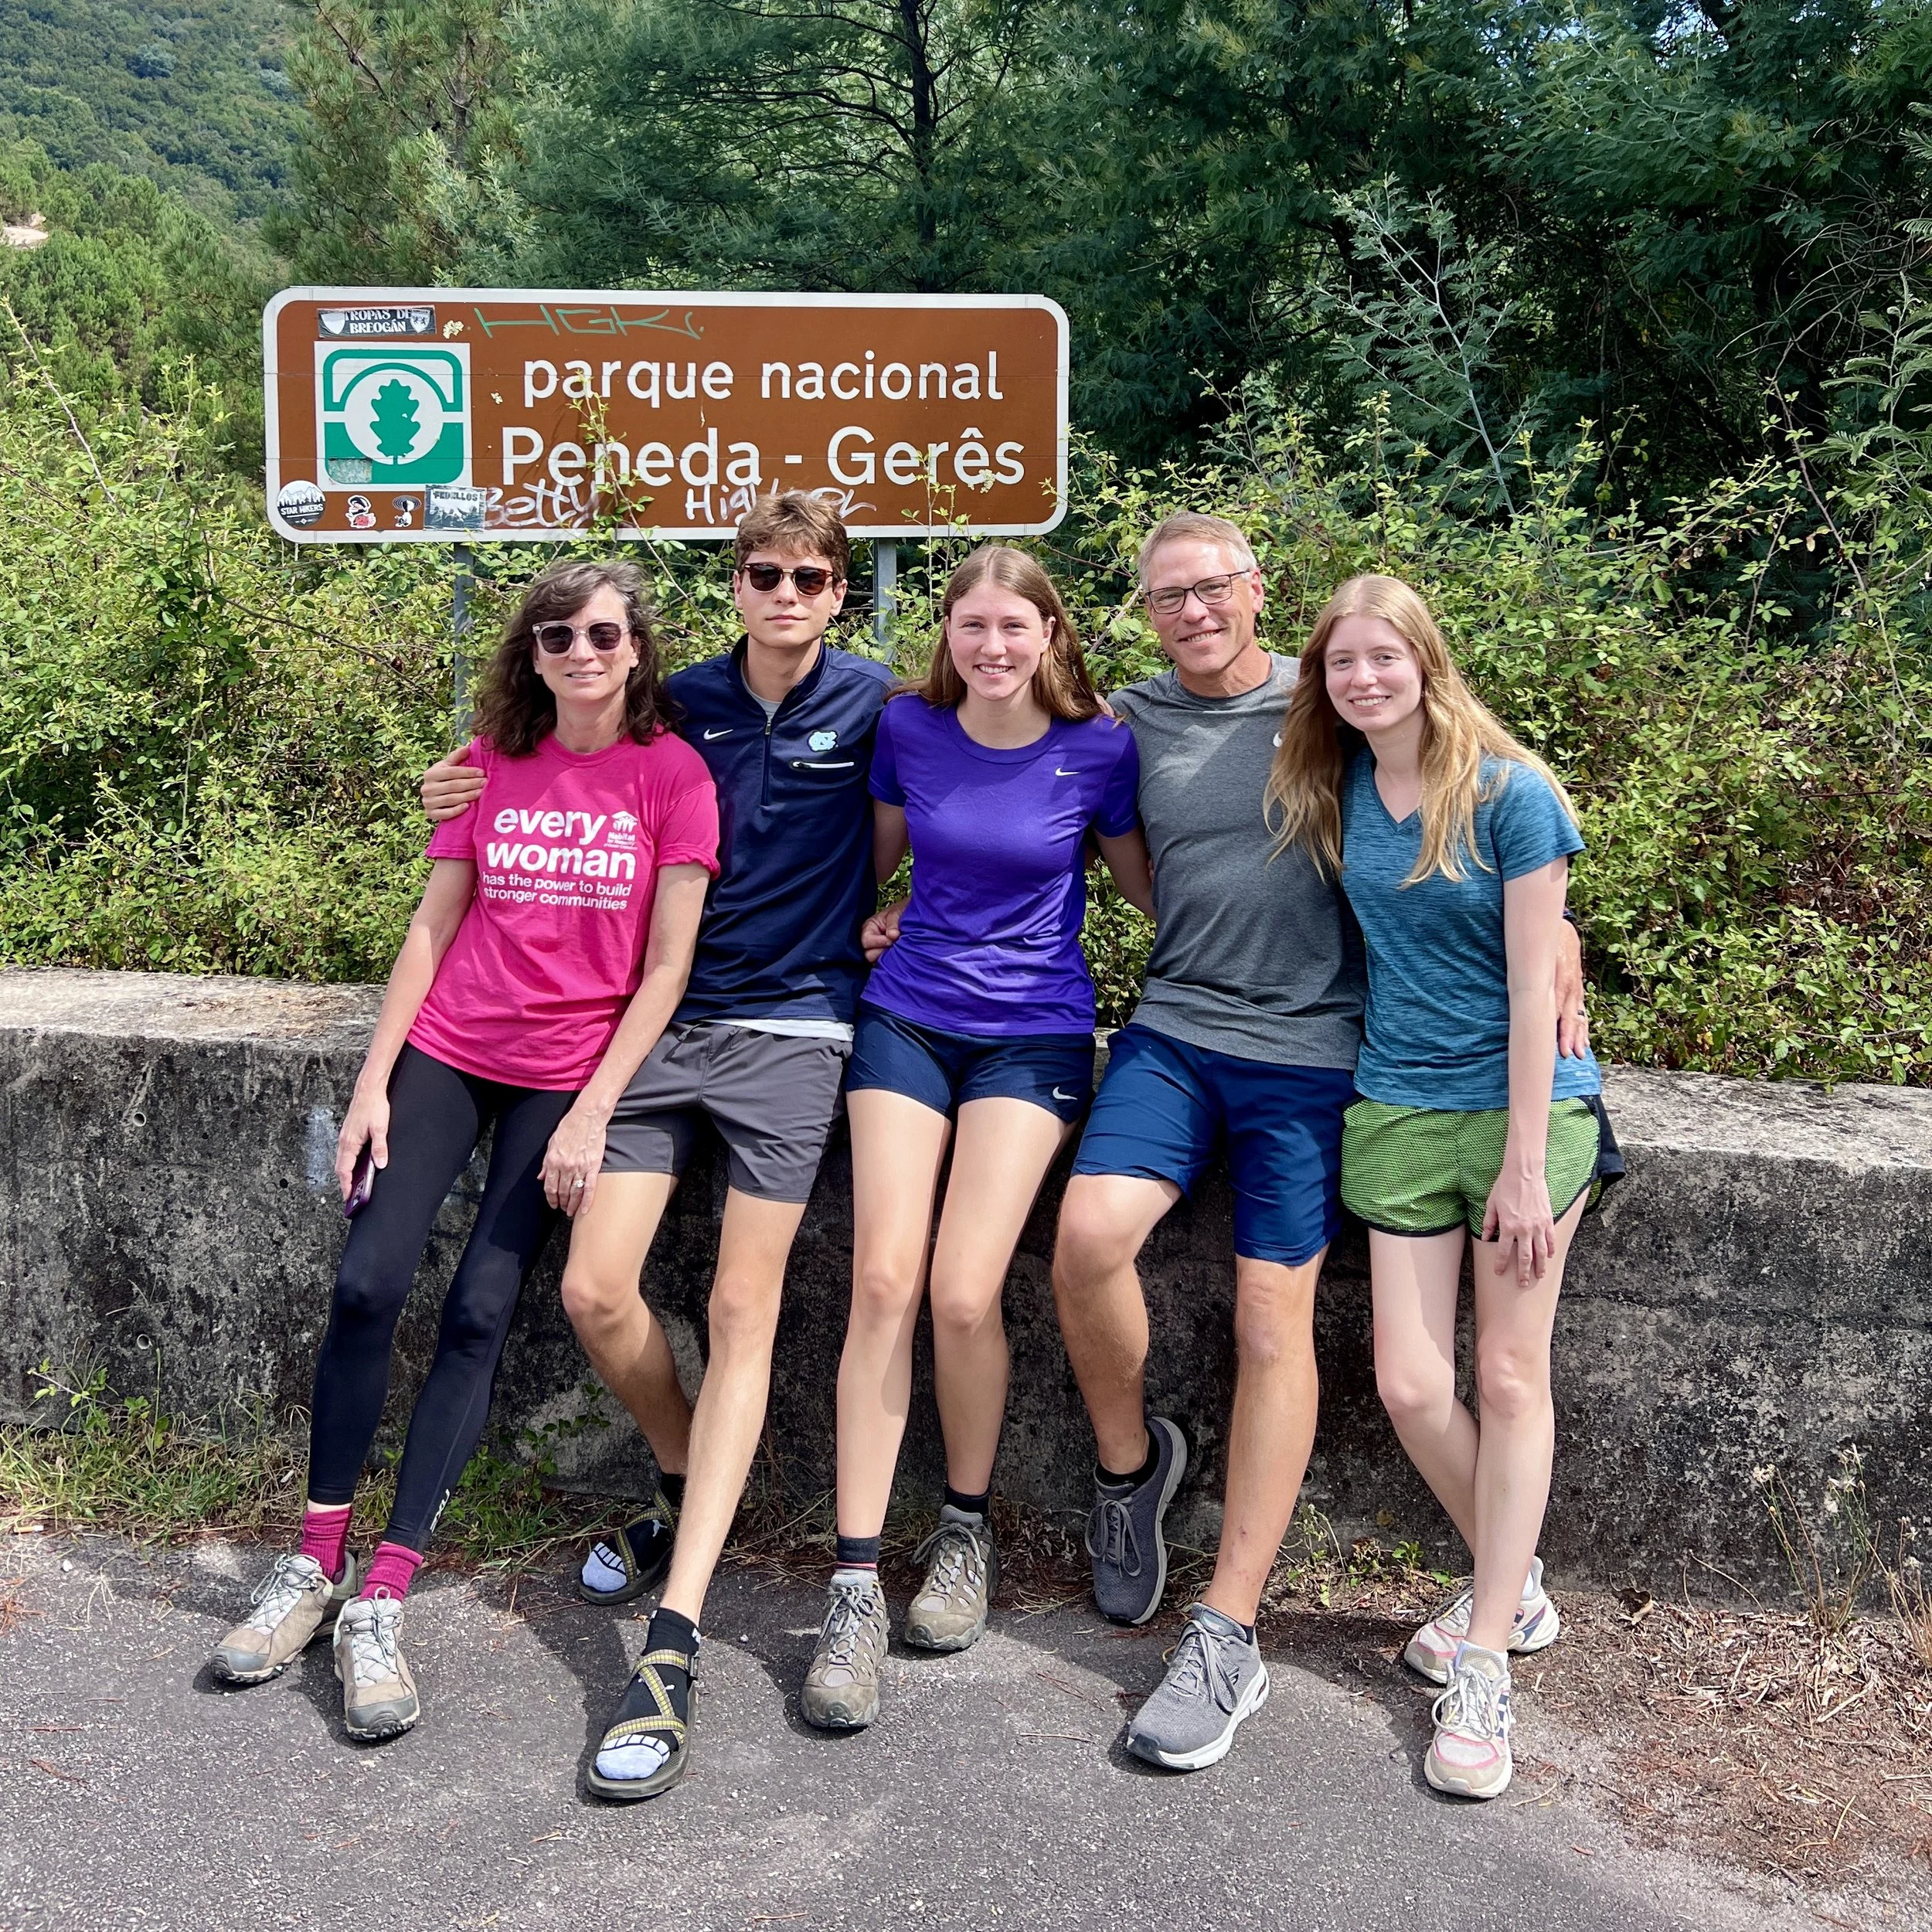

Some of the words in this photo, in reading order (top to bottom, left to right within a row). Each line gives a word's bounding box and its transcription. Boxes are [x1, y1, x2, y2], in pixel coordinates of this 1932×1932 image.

[349, 318, 406, 334] BREOGÁN
[524, 361, 734, 408] parque
[761, 349, 1004, 400] nacional
[502, 427, 763, 487] Peneda
[827, 426, 1025, 486] Gerês
[281, 506, 298, 515] STAR
[299, 504, 324, 514] HIKERS
[493, 808, 607, 845] every
[487, 842, 636, 879] woman
[482, 871, 505, 886] has
[509, 873, 532, 888] the
[534, 878, 576, 893] power
[579, 882, 594, 894] to
[596, 882, 632, 897] build
[484, 886, 537, 904] stronger
[539, 893, 628, 910] communities
